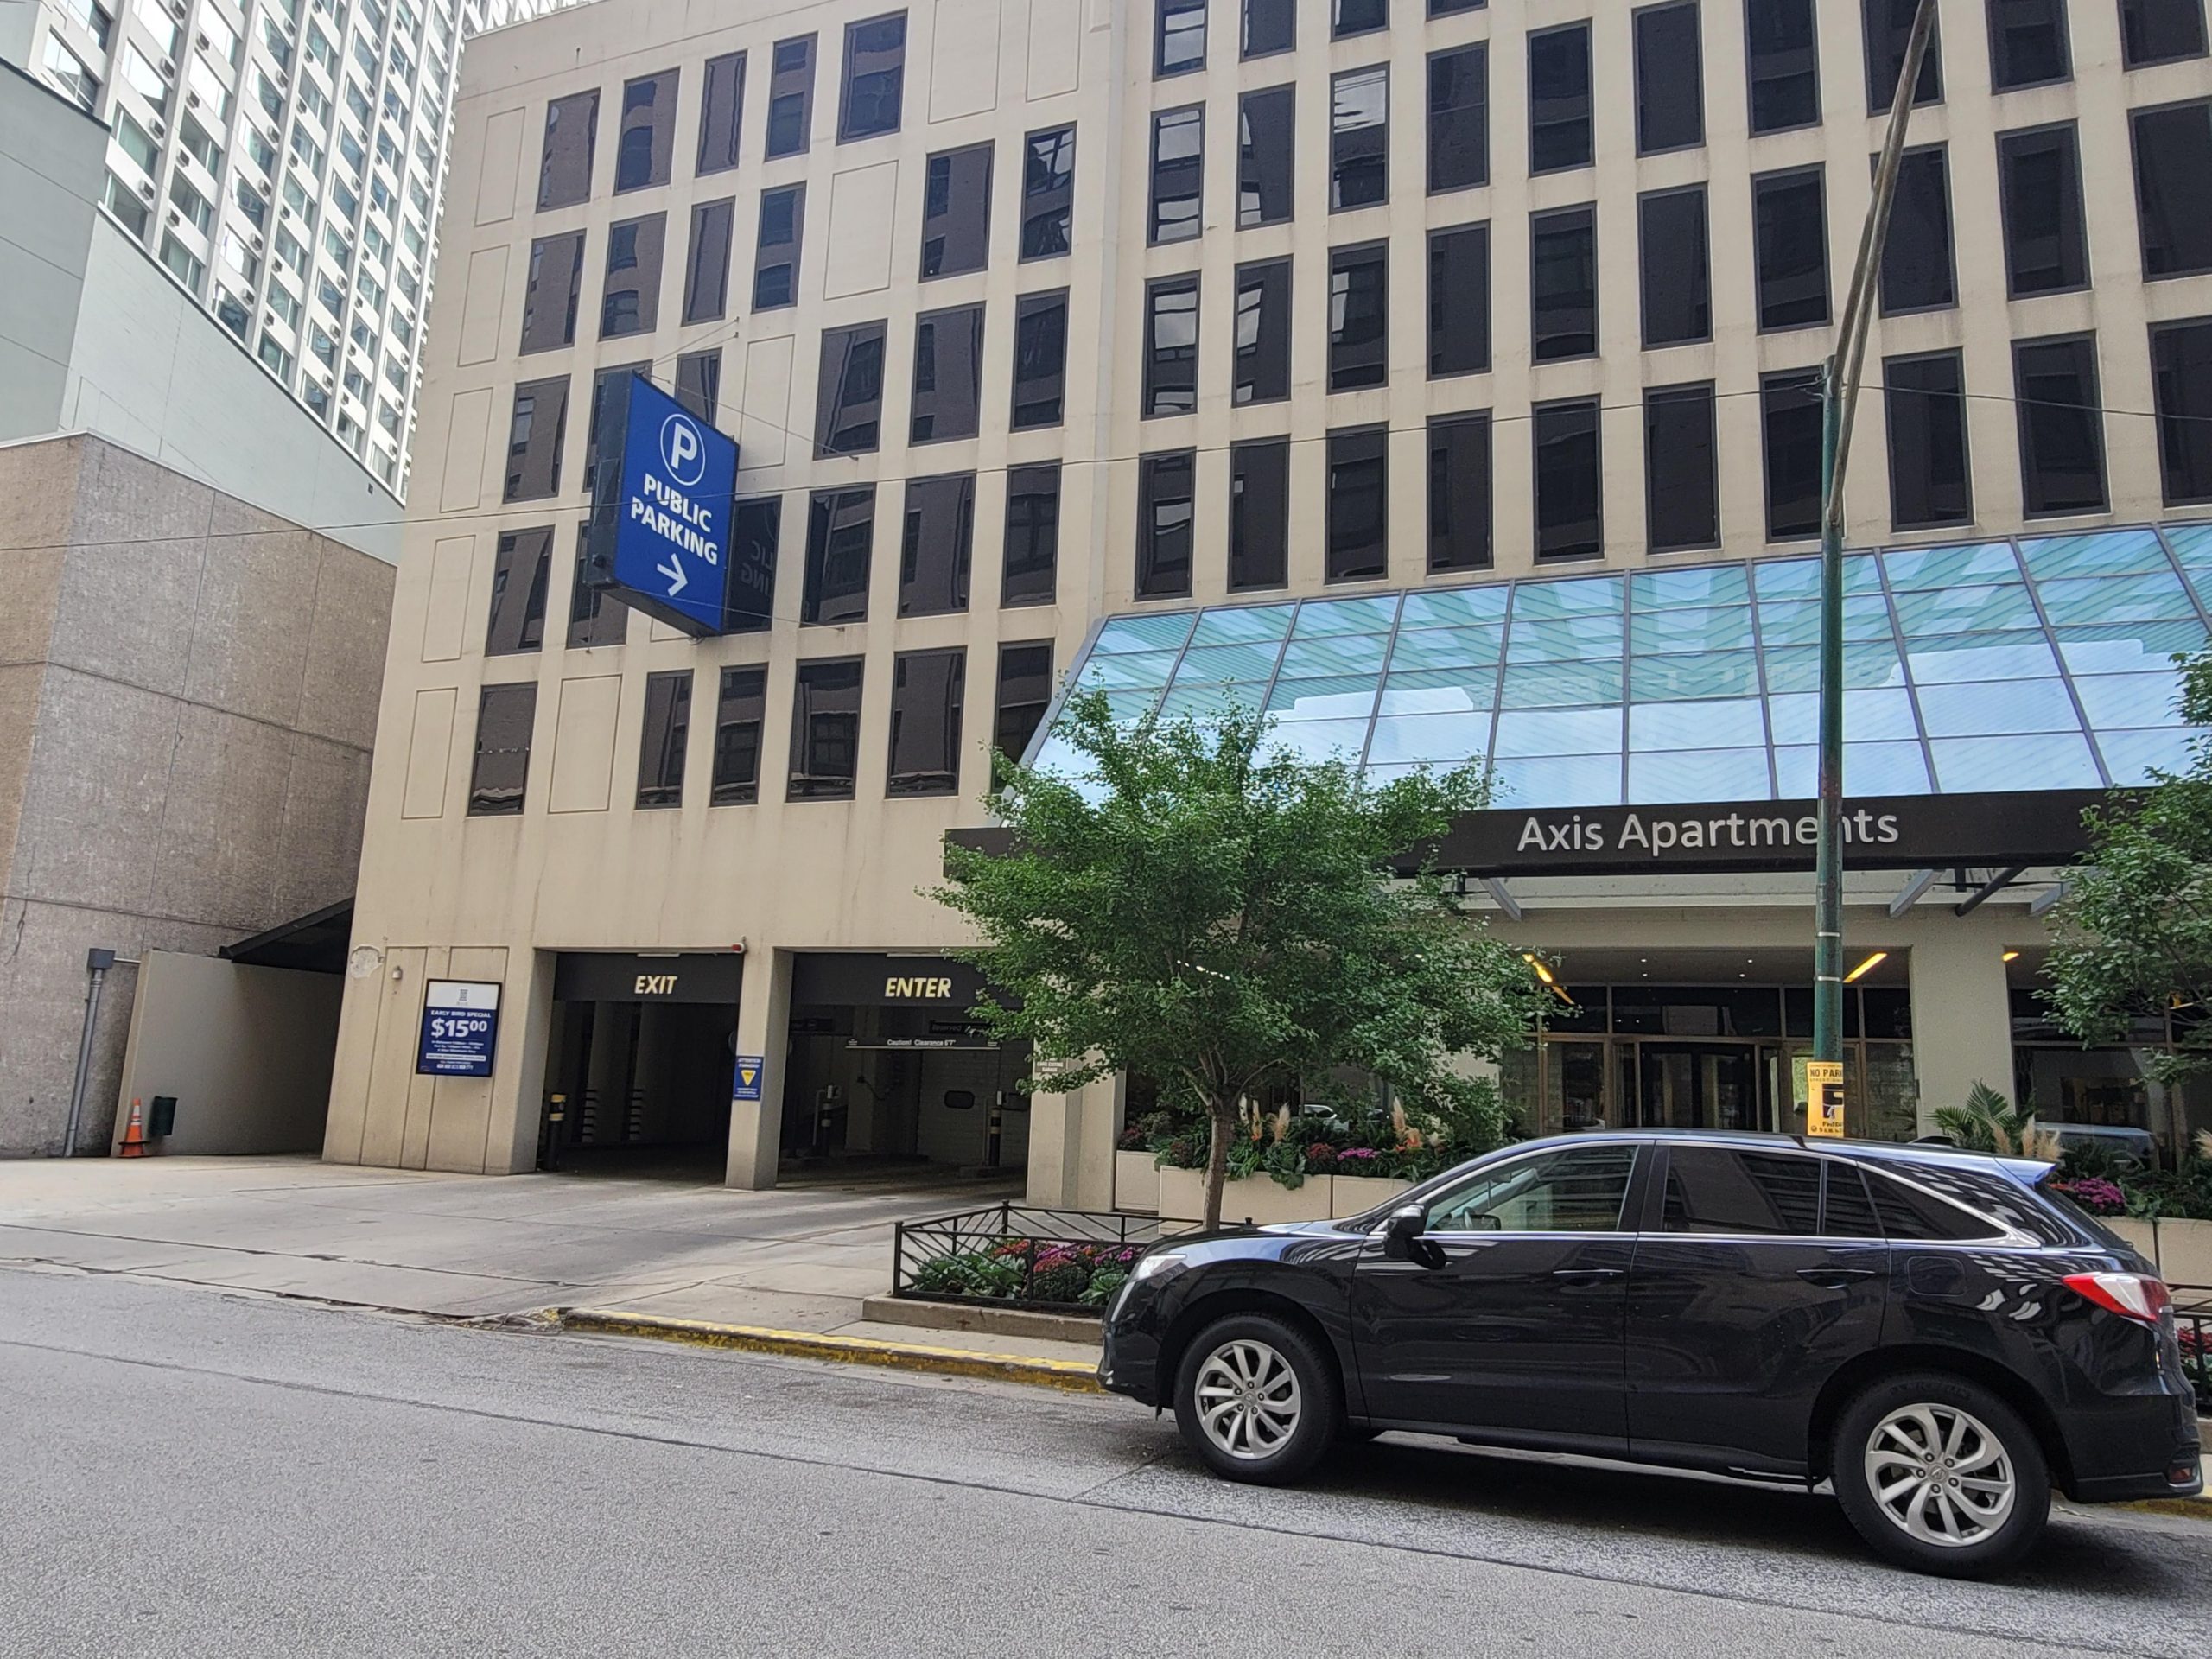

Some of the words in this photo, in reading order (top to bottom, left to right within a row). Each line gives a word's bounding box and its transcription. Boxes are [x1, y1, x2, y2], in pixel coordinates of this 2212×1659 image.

[671, 422, 698, 470] P
[643, 473, 712, 532] PUBLIC
[631, 496, 718, 566] PARKING
[1517, 814, 1605, 851] Axis
[634, 975, 678, 995] EXIT
[884, 977, 952, 998] ENTER
[1809, 1068, 1821, 1077] NO
